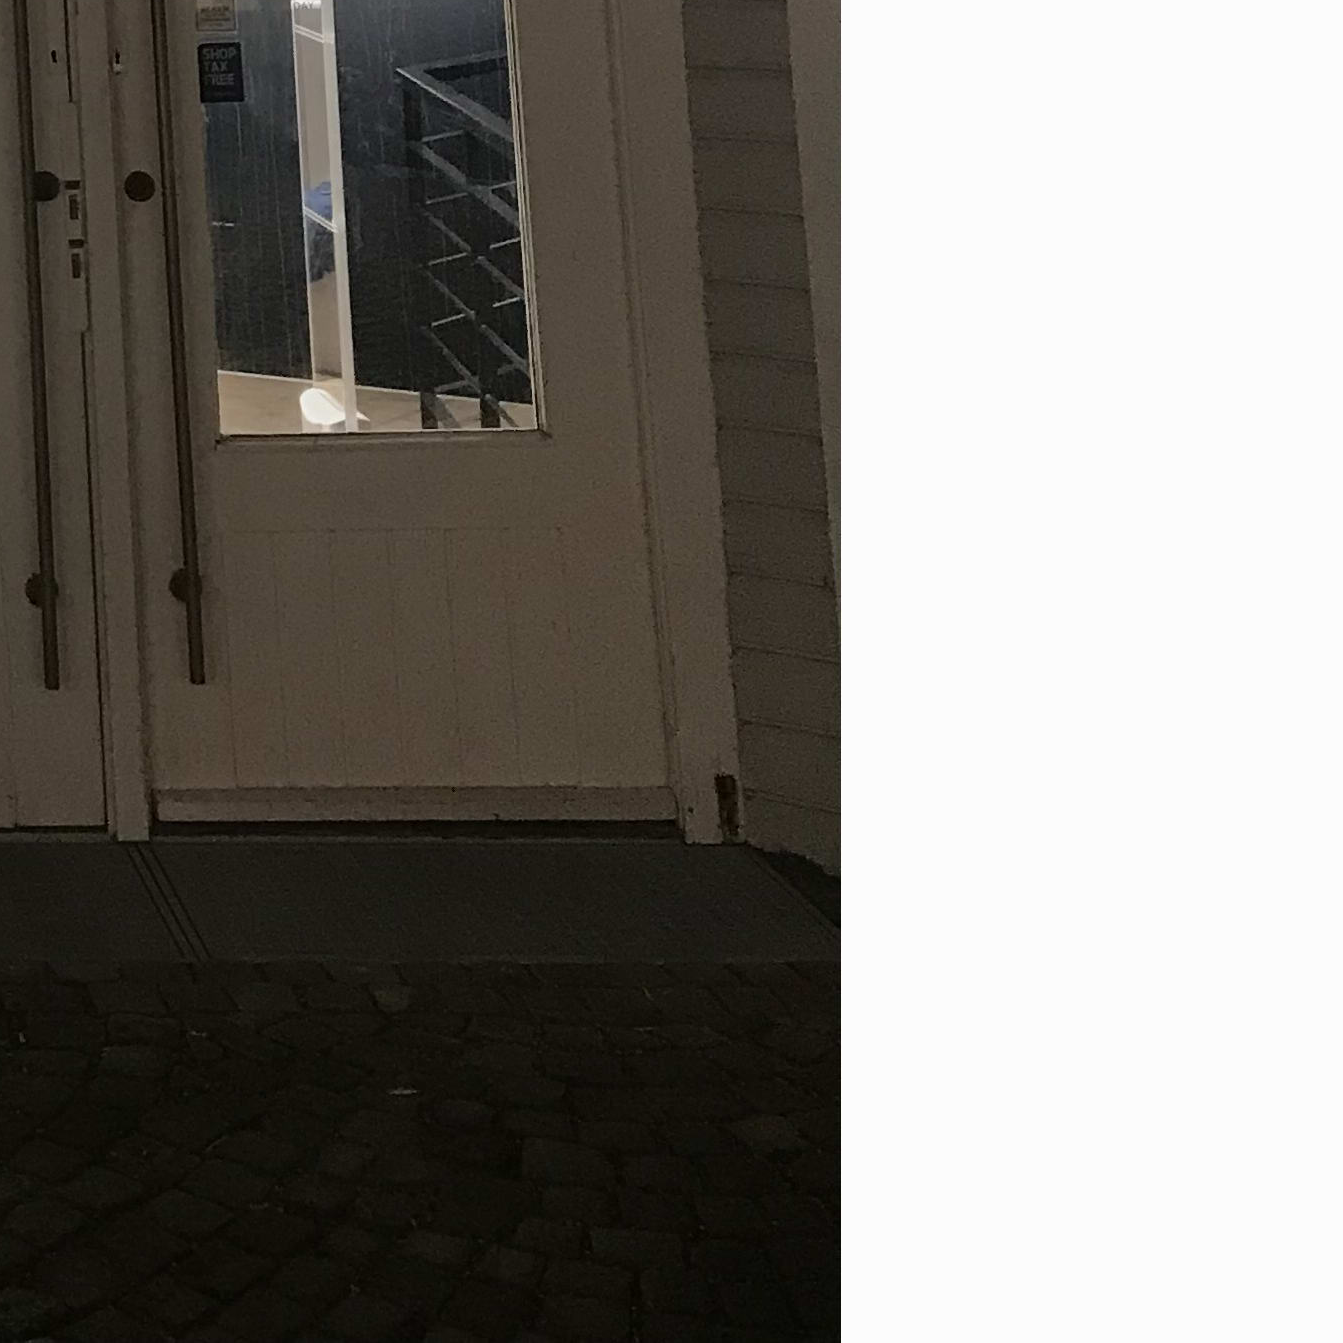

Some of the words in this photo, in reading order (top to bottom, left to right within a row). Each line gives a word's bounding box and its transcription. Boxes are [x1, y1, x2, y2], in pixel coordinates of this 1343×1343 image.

[202, 47, 236, 59] SHOP
[203, 61, 228, 72] TAX
[204, 73, 235, 86] FREE
